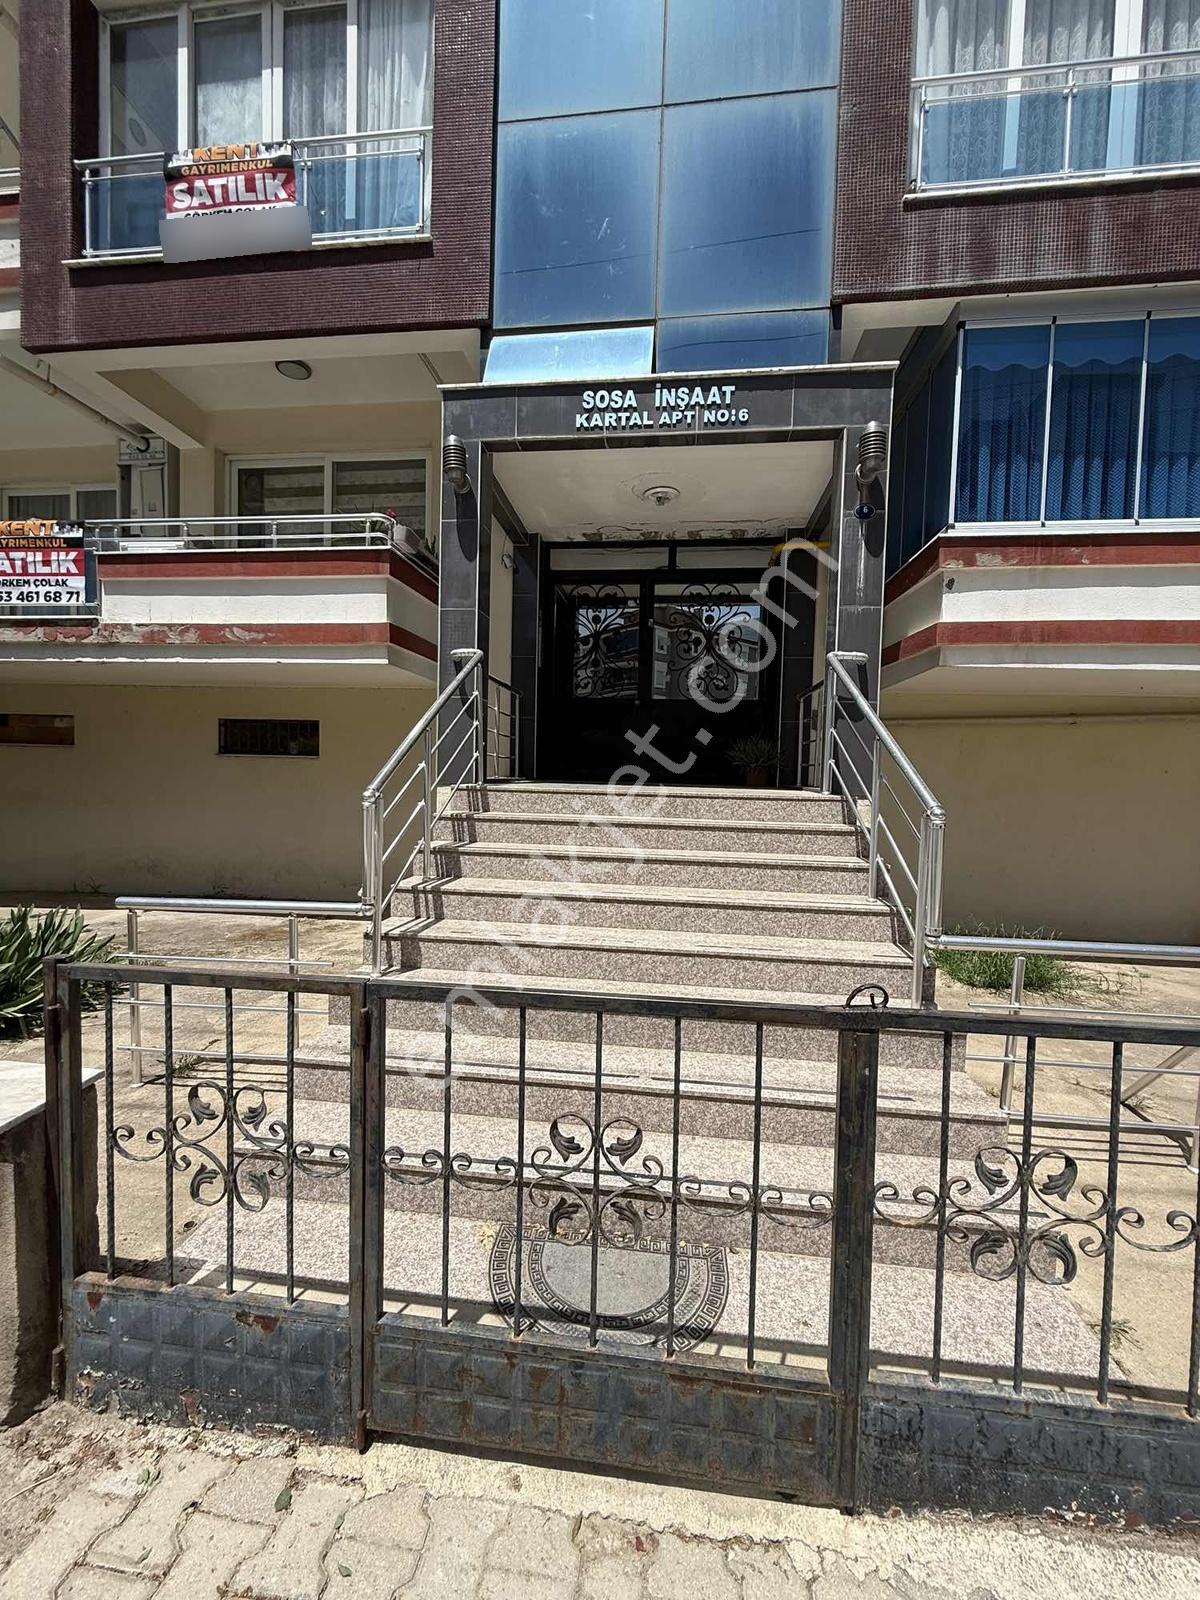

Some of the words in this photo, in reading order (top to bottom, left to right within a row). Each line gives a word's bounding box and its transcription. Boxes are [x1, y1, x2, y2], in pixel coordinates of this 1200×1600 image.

[193, 142, 259, 162] KENT
[181, 159, 273, 177] GAYRIMENKUL
[172, 173, 289, 209] SATILIK
[582, 389, 637, 409] SOSA
[655, 383, 736, 411] İNŞAAT
[575, 411, 654, 428] KARTAL
[659, 411, 696, 425] APT
[703, 408, 749, 423] NO:6
[0, 538, 67, 548] YRIMENKUL
[0, 578, 31, 588] RKEM
[33, 578, 69, 589] ÇOLAK
[16, 591, 40, 603] 461
[43, 591, 63, 603] 68
[66, 591, 80, 603] 71
